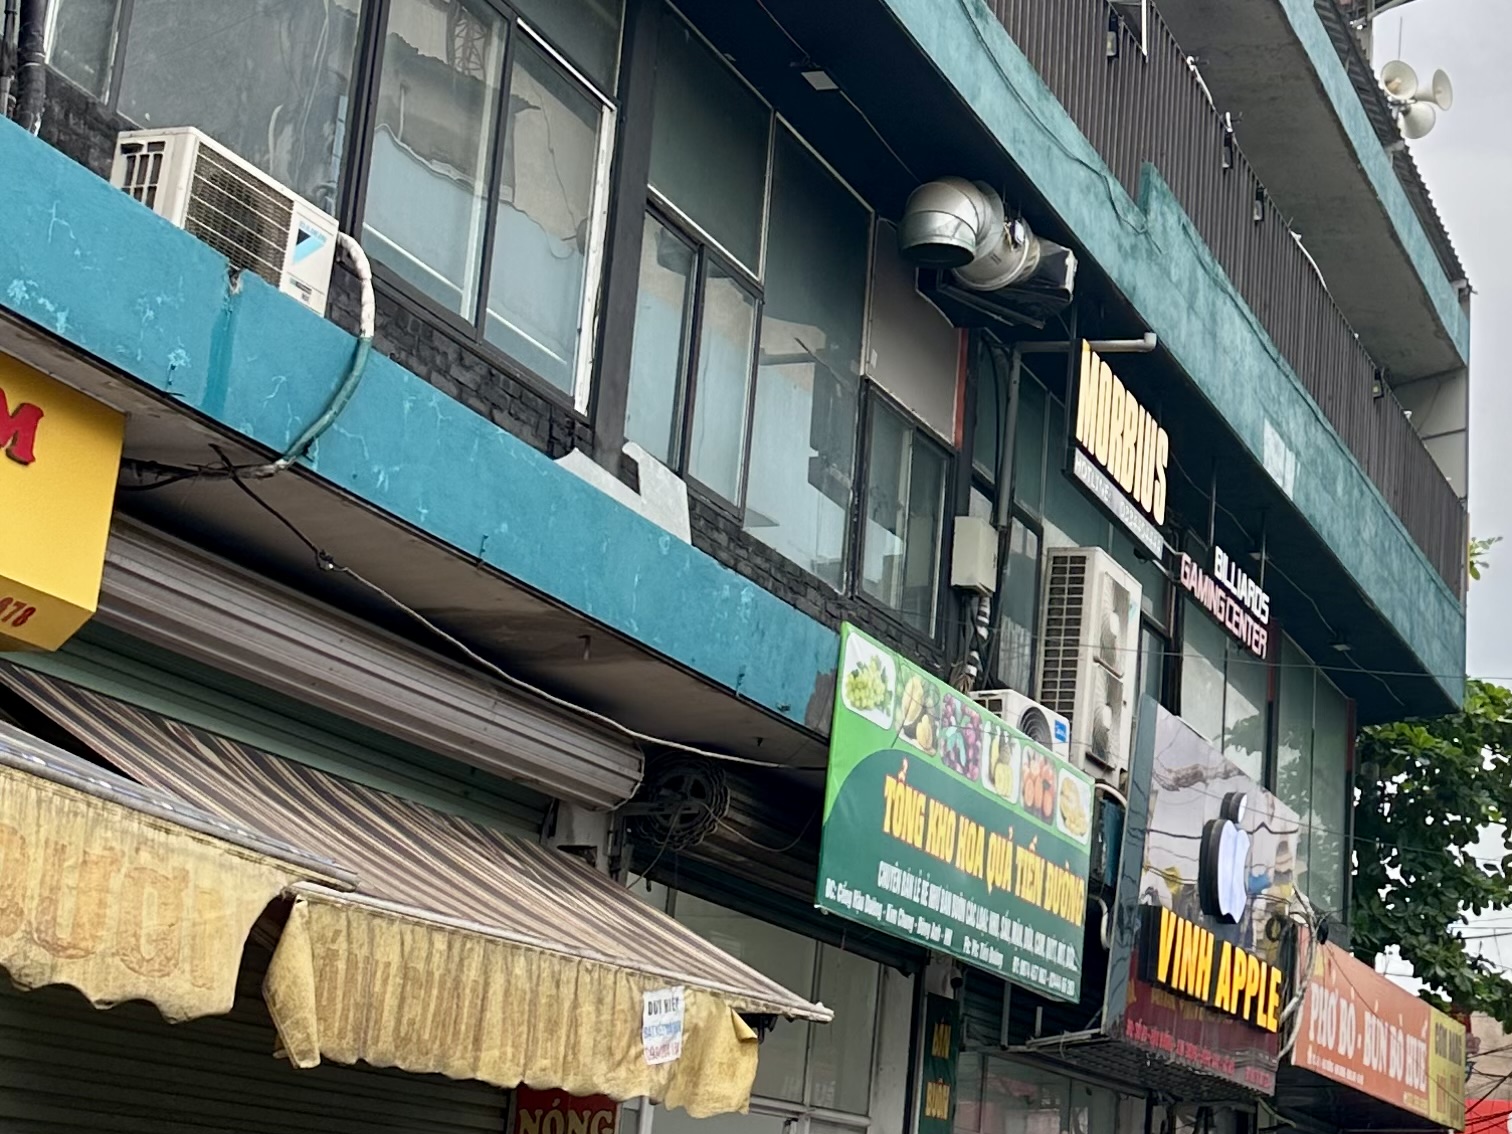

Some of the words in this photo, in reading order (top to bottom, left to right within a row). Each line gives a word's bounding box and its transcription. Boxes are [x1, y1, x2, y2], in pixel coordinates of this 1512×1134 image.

[1076, 339, 1169, 526] MORBIUS
[1214, 546, 1270, 625] BILLIARDS
[883, 757, 927, 849] TỔNG
[925, 799, 956, 863] KHO
[956, 815, 985, 879] HOA
[986, 825, 1013, 896] QUẢ
[1156, 907, 1215, 1002] VINH
[1215, 941, 1282, 1034] APPLE
[1309, 968, 1339, 1050] PHỞ
[1363, 1000, 1389, 1075] BÚN
